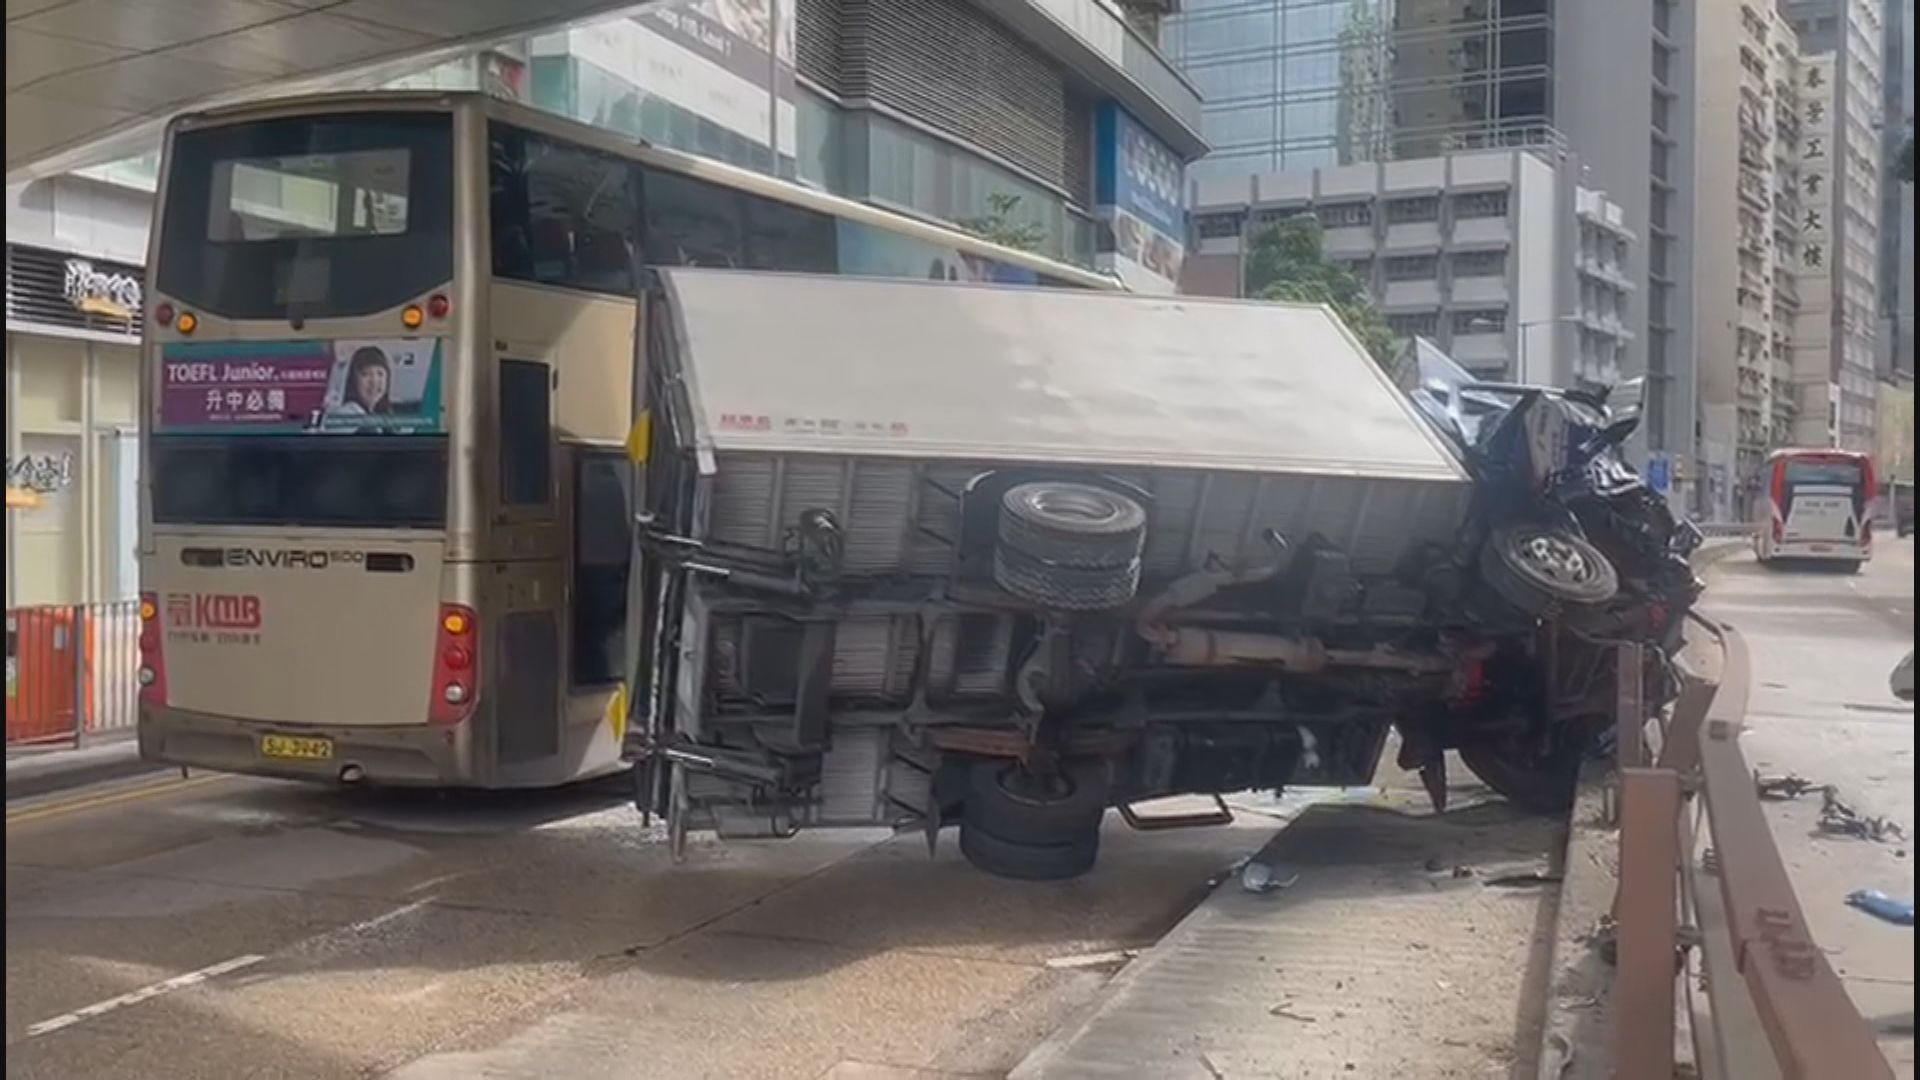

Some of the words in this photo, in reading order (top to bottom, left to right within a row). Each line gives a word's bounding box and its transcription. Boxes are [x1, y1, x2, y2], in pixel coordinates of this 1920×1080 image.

[168, 364, 218, 382] TOEFL
[206, 390, 285, 411] 升中必備
[196, 593, 262, 628] KMB
